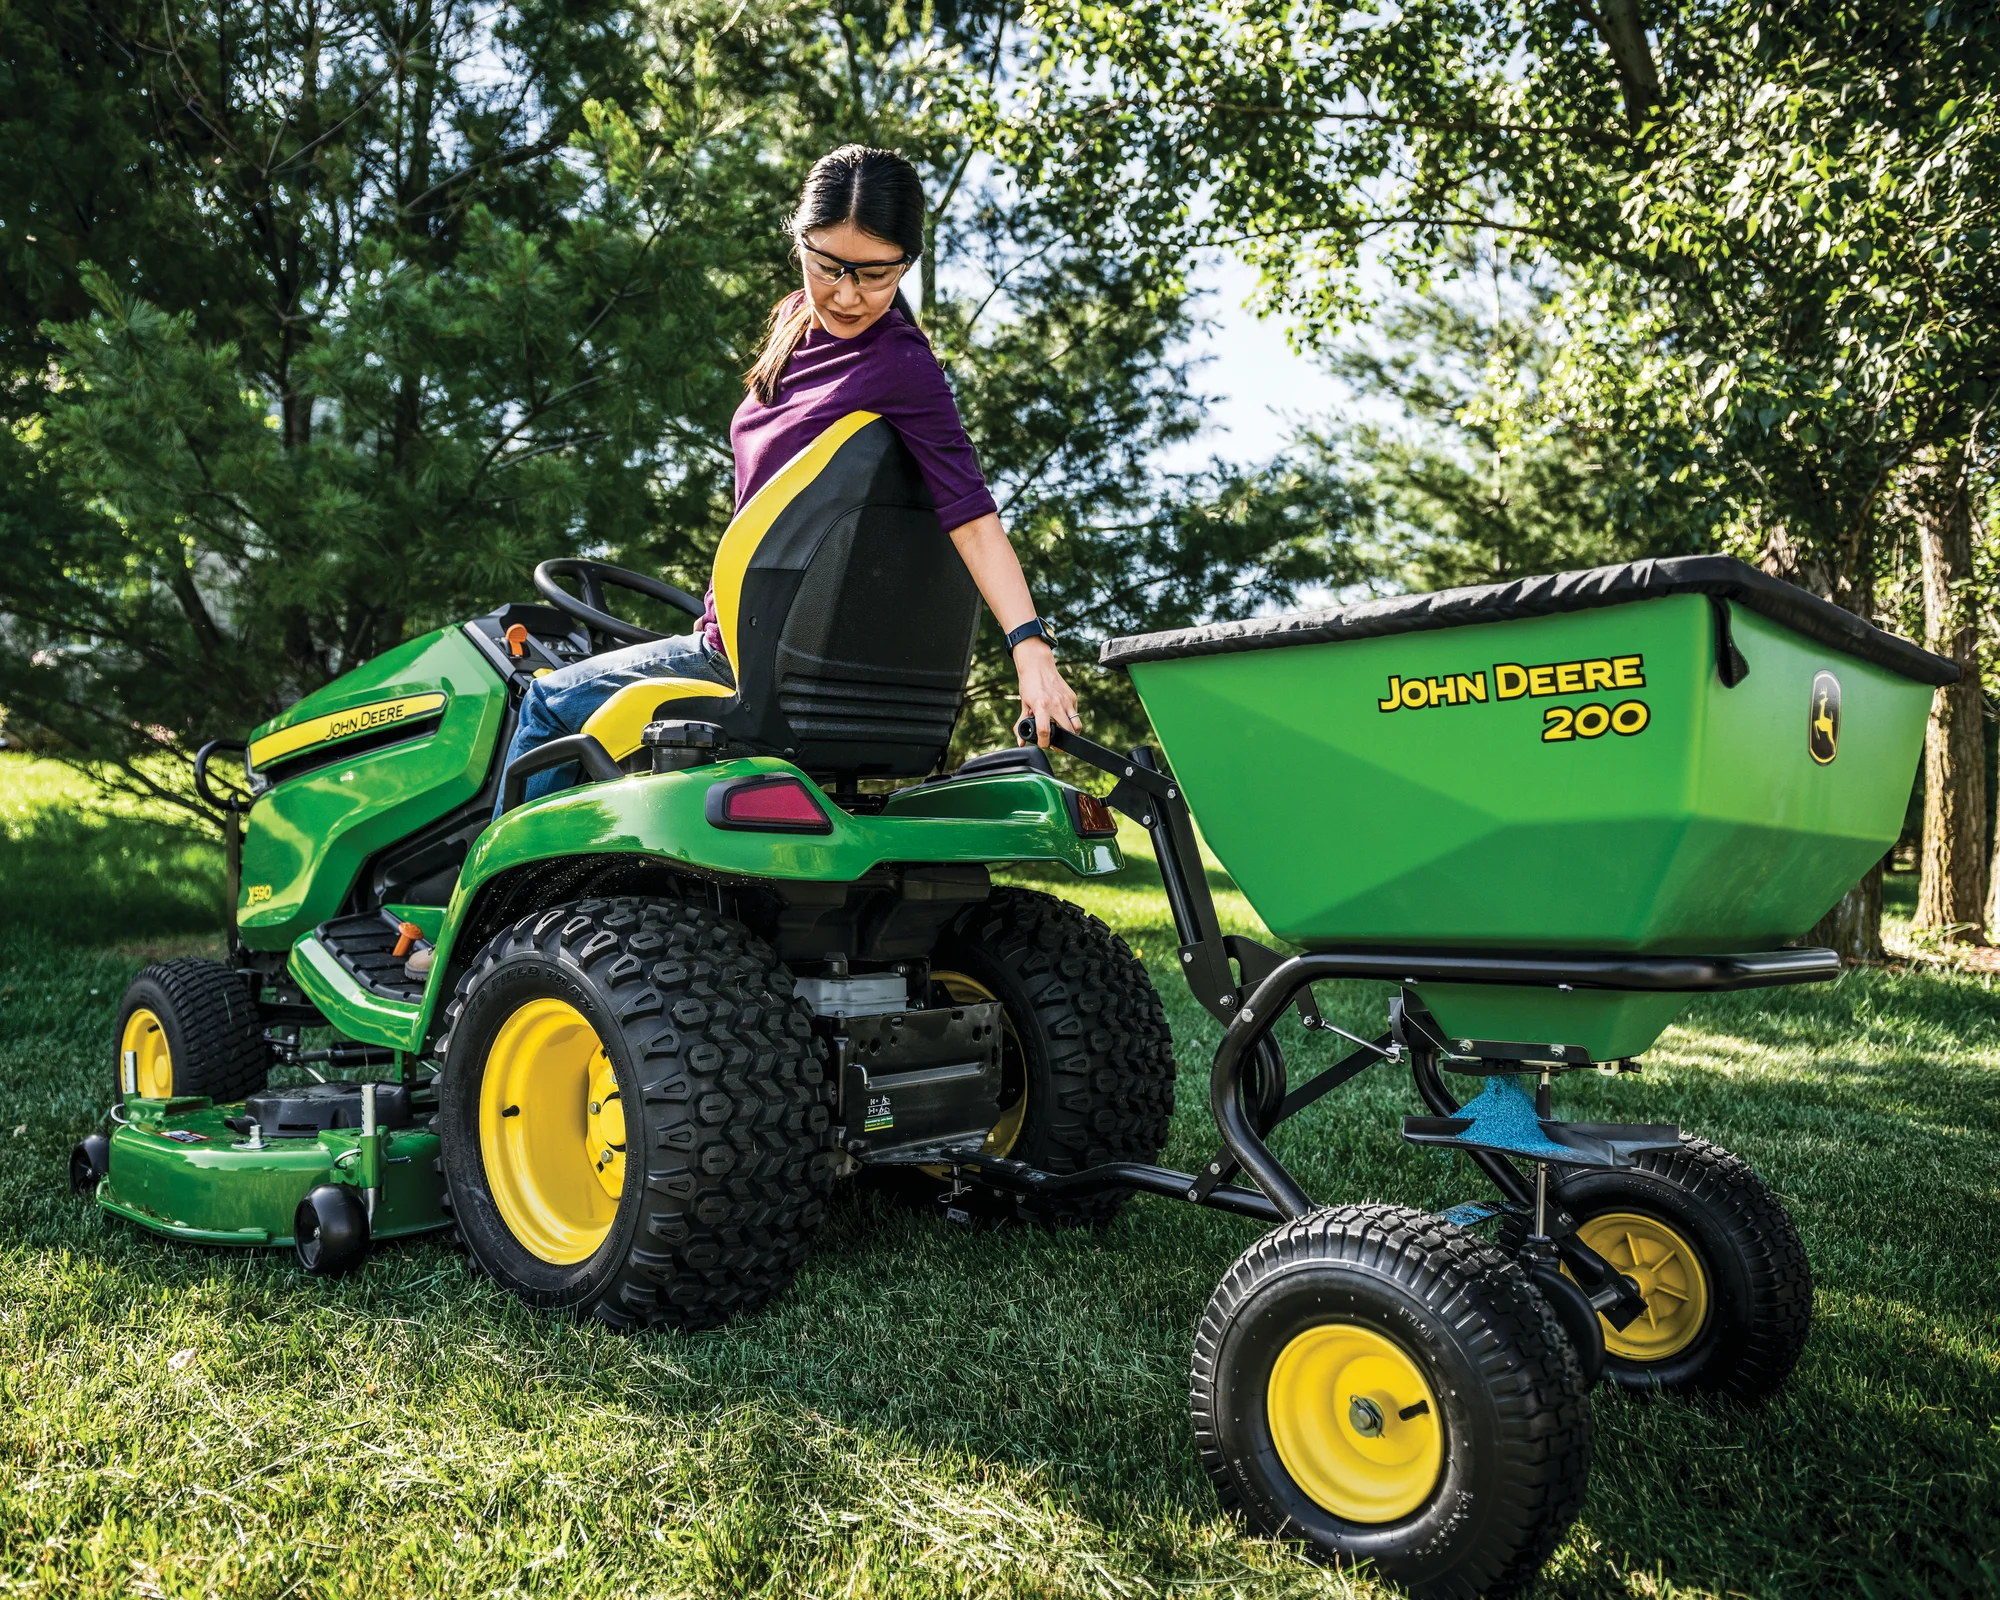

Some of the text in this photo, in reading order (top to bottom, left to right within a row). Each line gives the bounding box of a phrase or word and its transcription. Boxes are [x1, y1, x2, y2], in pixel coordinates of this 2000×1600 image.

[1379, 655, 1645, 711] JOHN DEERE
[326, 705, 404, 739] JOHN DEERE
[1542, 700, 1650, 741] 200
[491, 965, 540, 991] FIELD
[545, 967, 597, 1013] TRAX
[1399, 1306, 1435, 1342] NYLON
